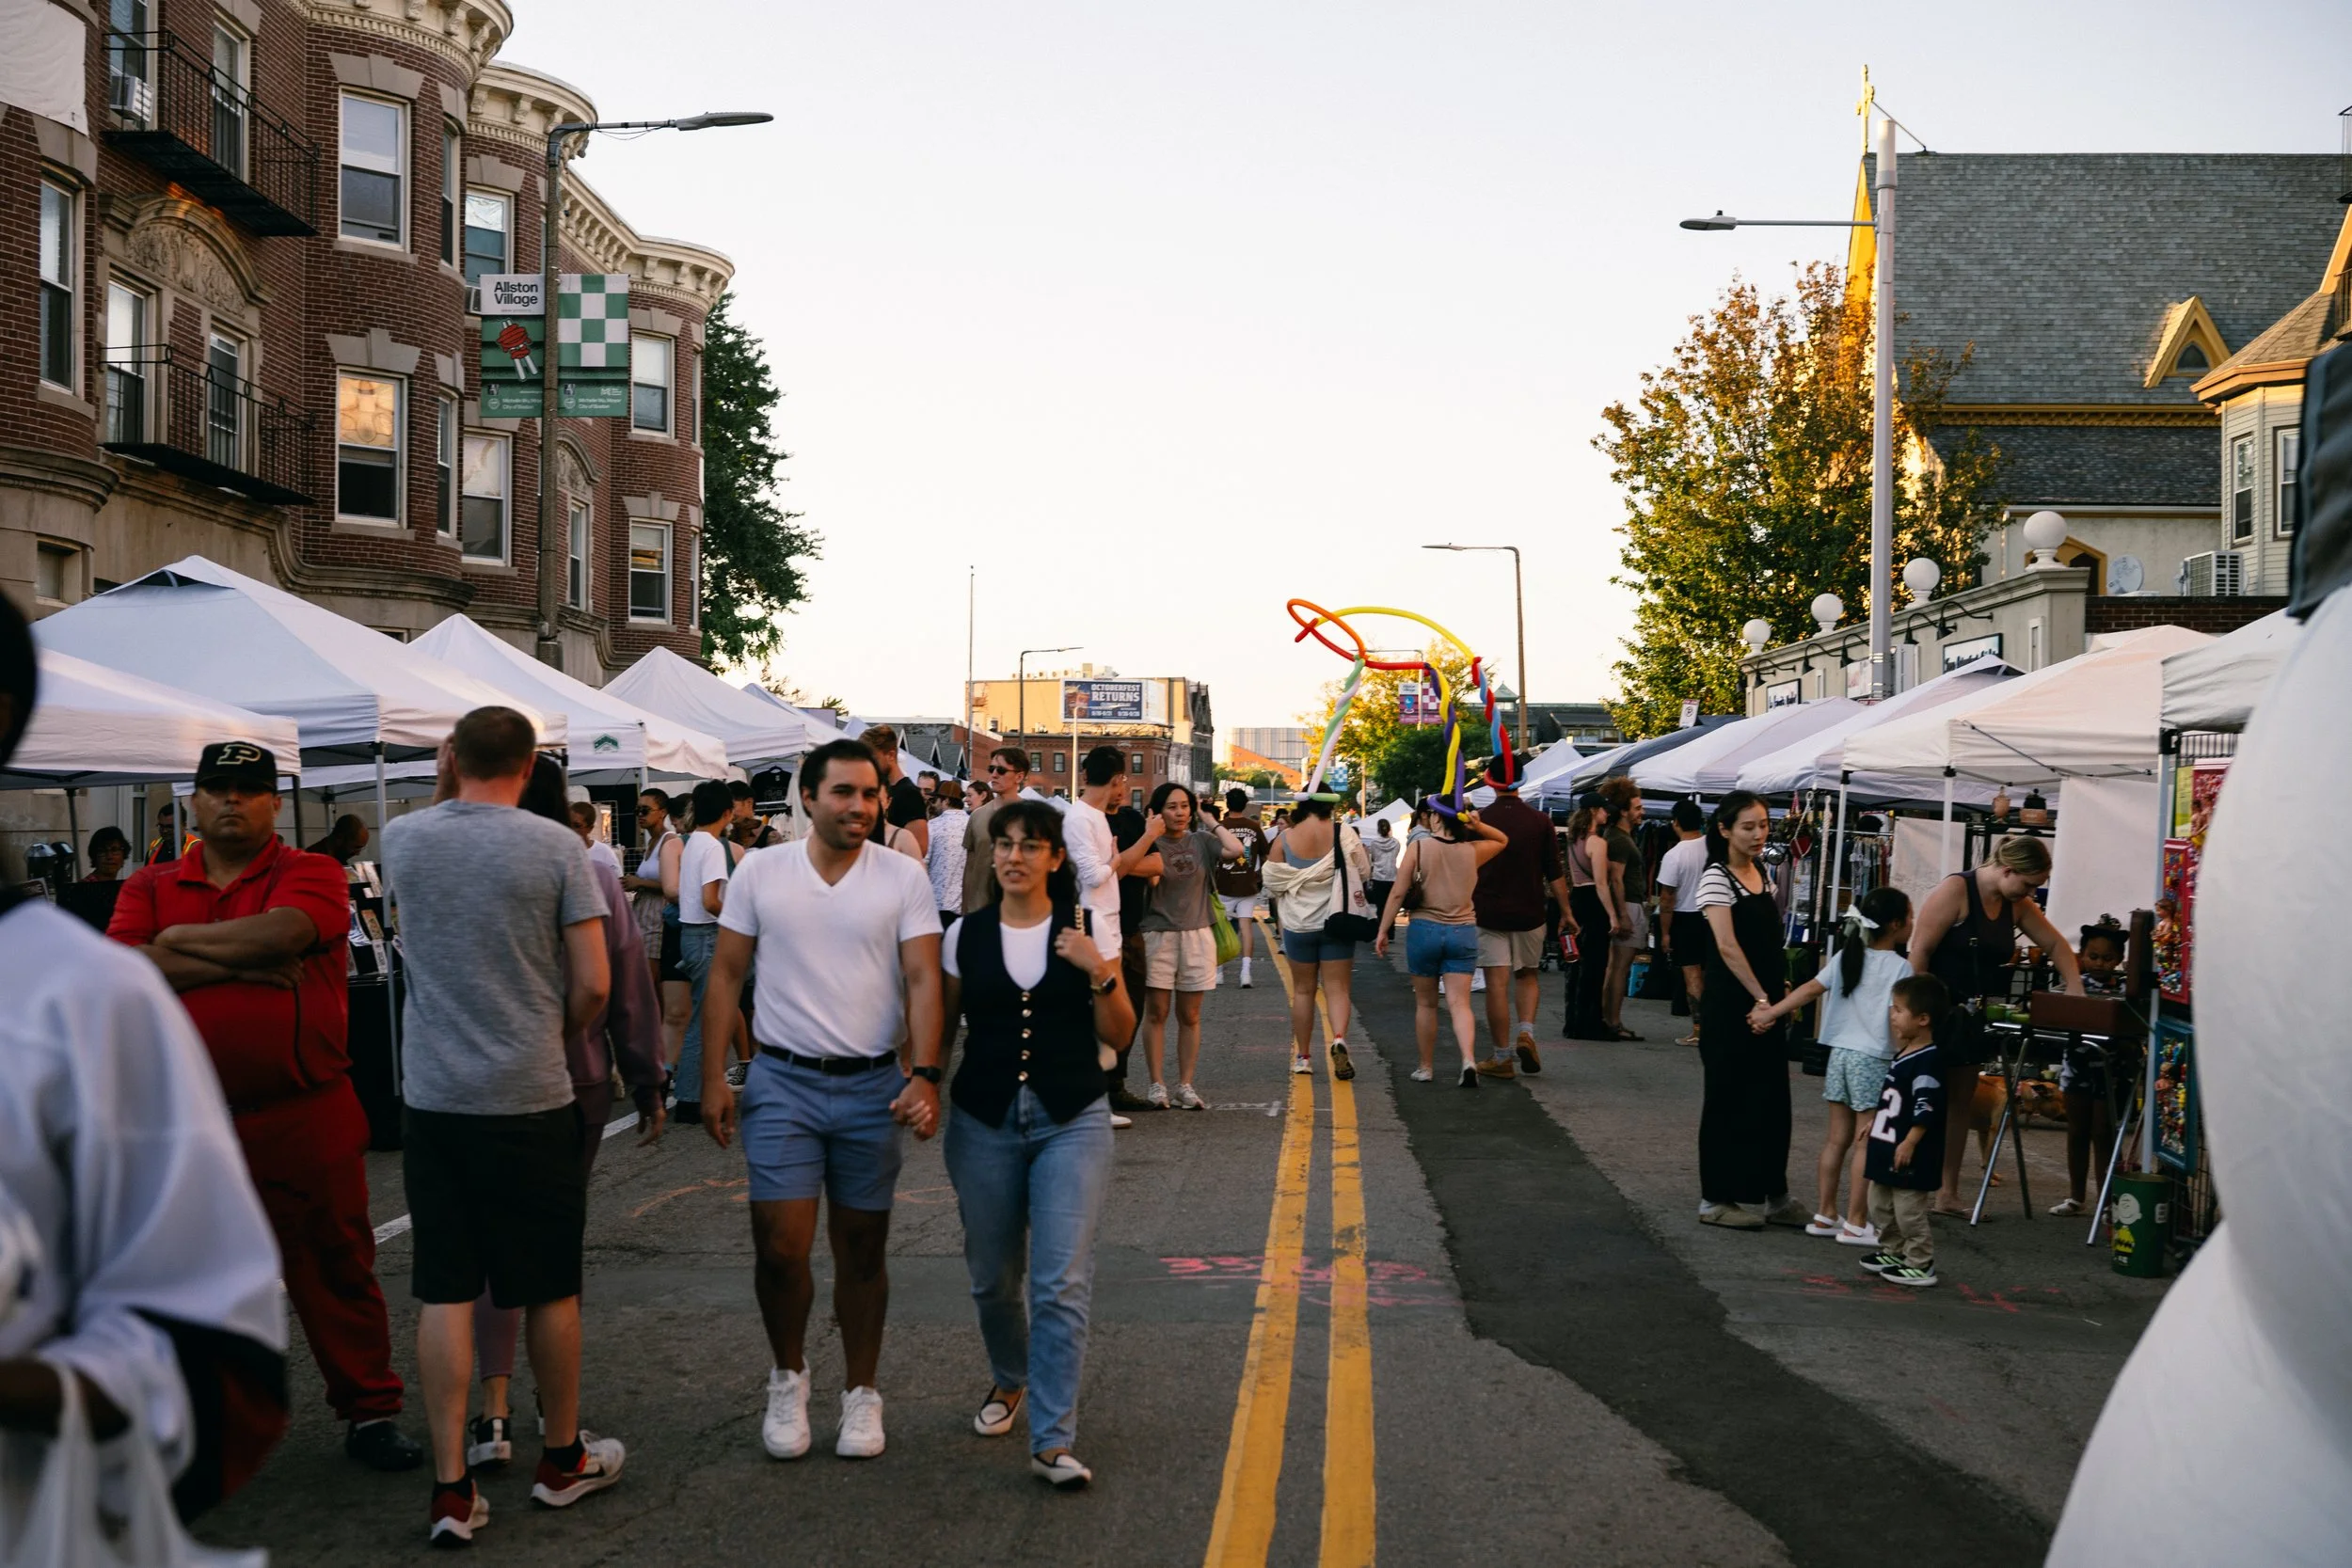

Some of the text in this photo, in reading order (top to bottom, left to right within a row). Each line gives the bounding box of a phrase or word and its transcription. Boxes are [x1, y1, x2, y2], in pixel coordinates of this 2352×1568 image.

[494, 281, 539, 293] Allston
[494, 293, 538, 308] Village
[1091, 691, 1140, 702] RETURNS
[215, 743, 262, 766] P
[1869, 1087, 1902, 1145] 2
